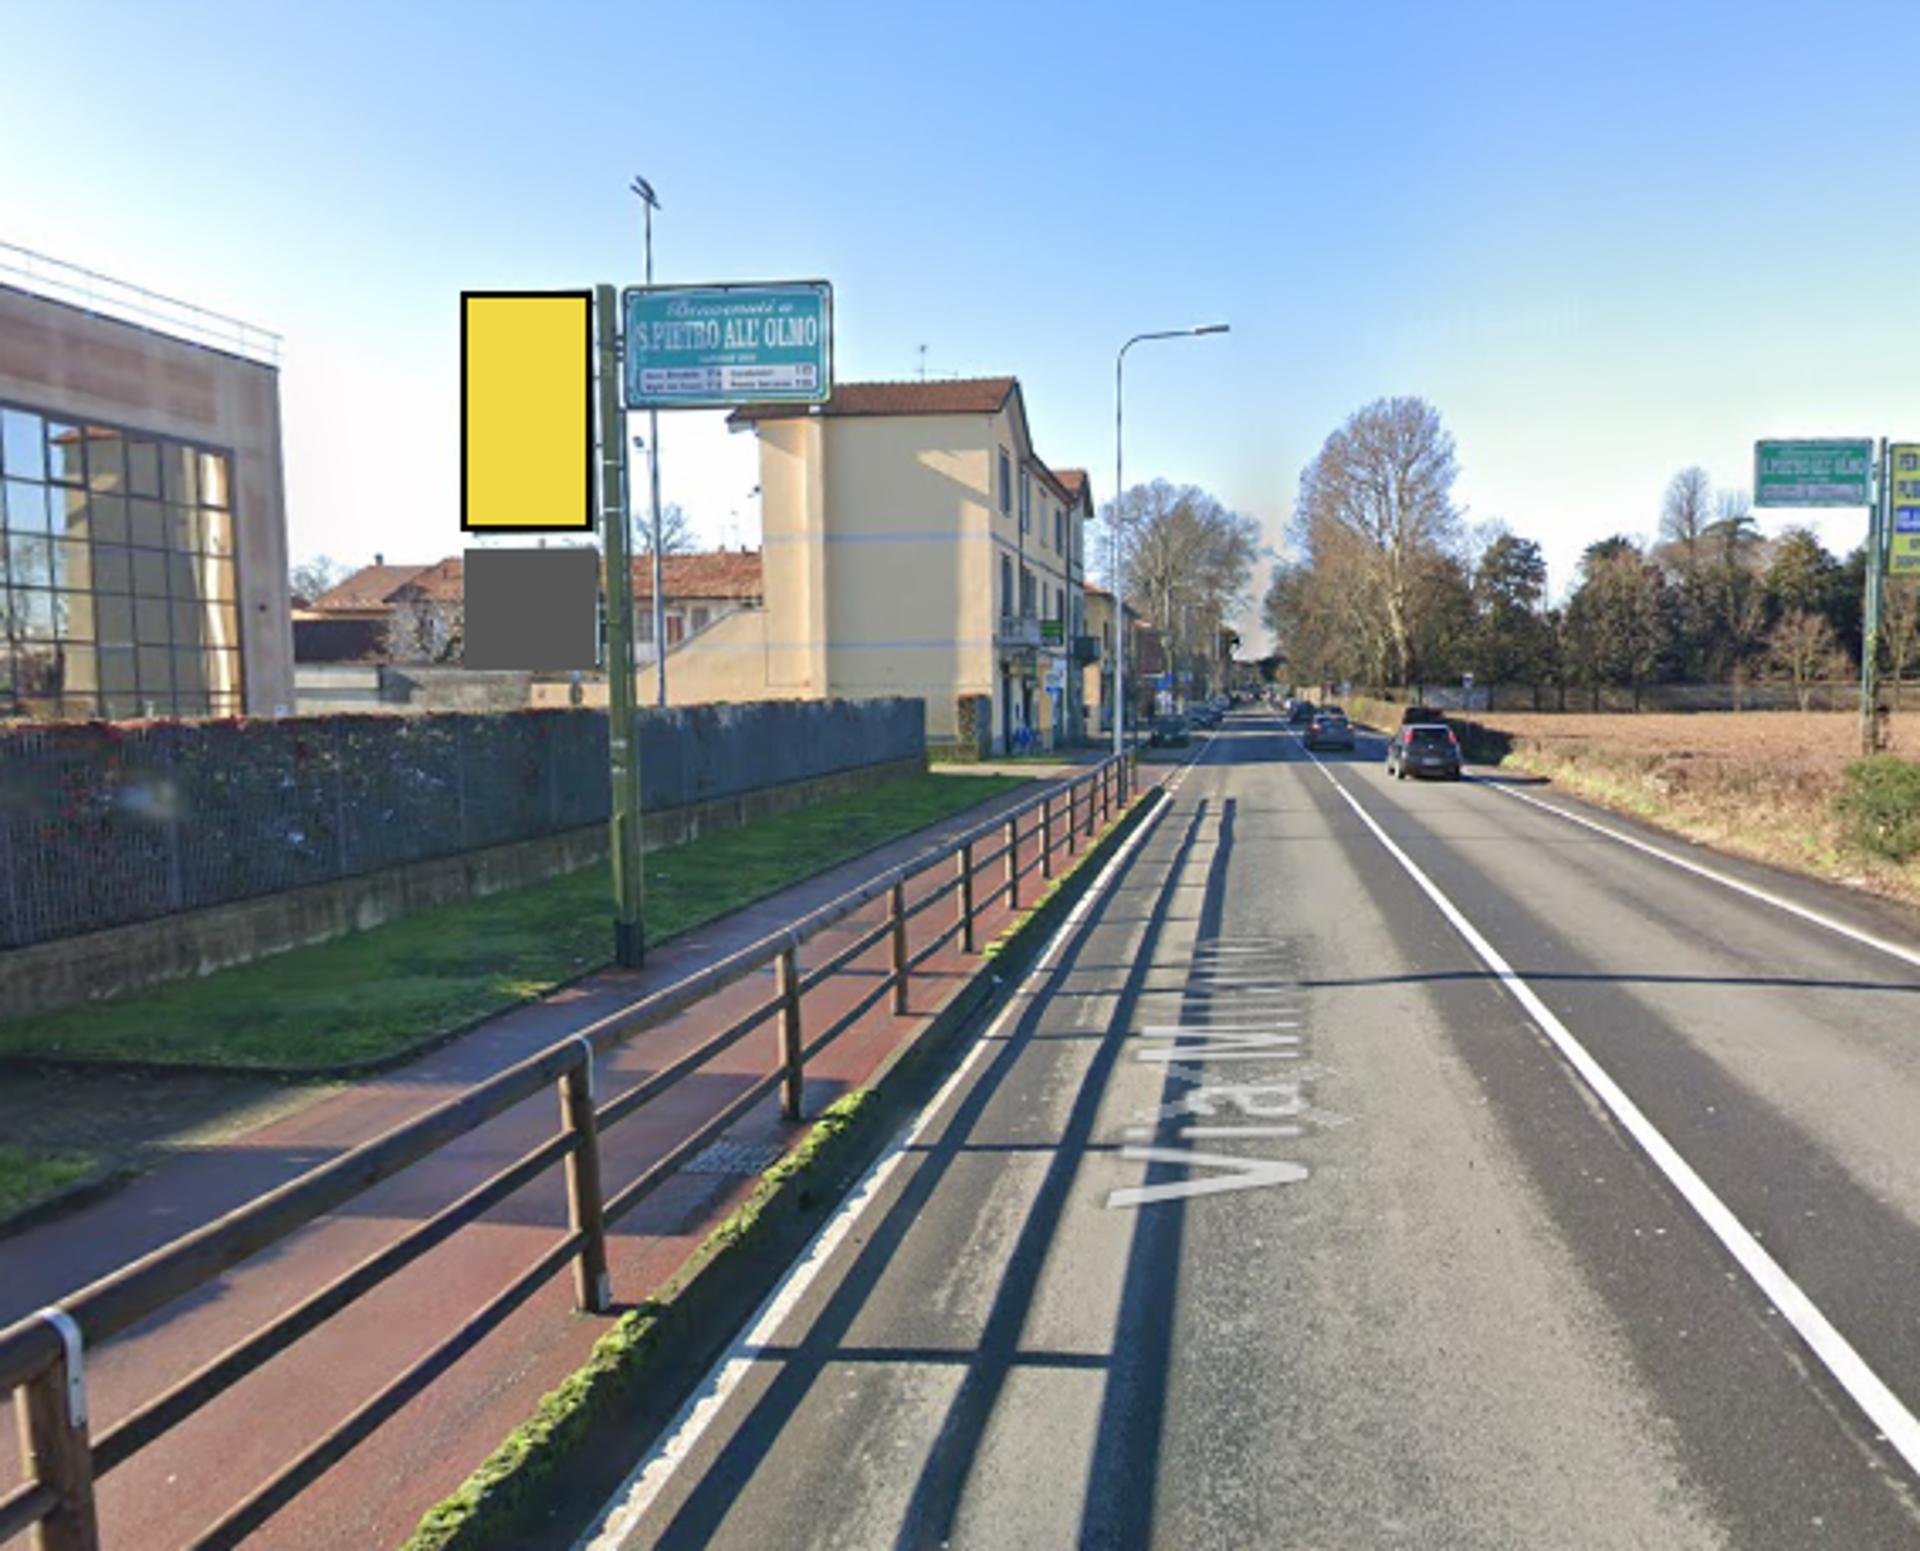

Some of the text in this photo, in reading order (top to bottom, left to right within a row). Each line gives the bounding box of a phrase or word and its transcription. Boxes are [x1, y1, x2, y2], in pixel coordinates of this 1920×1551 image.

[637, 315, 817, 350] S.PIETRO ALL' OLMO
